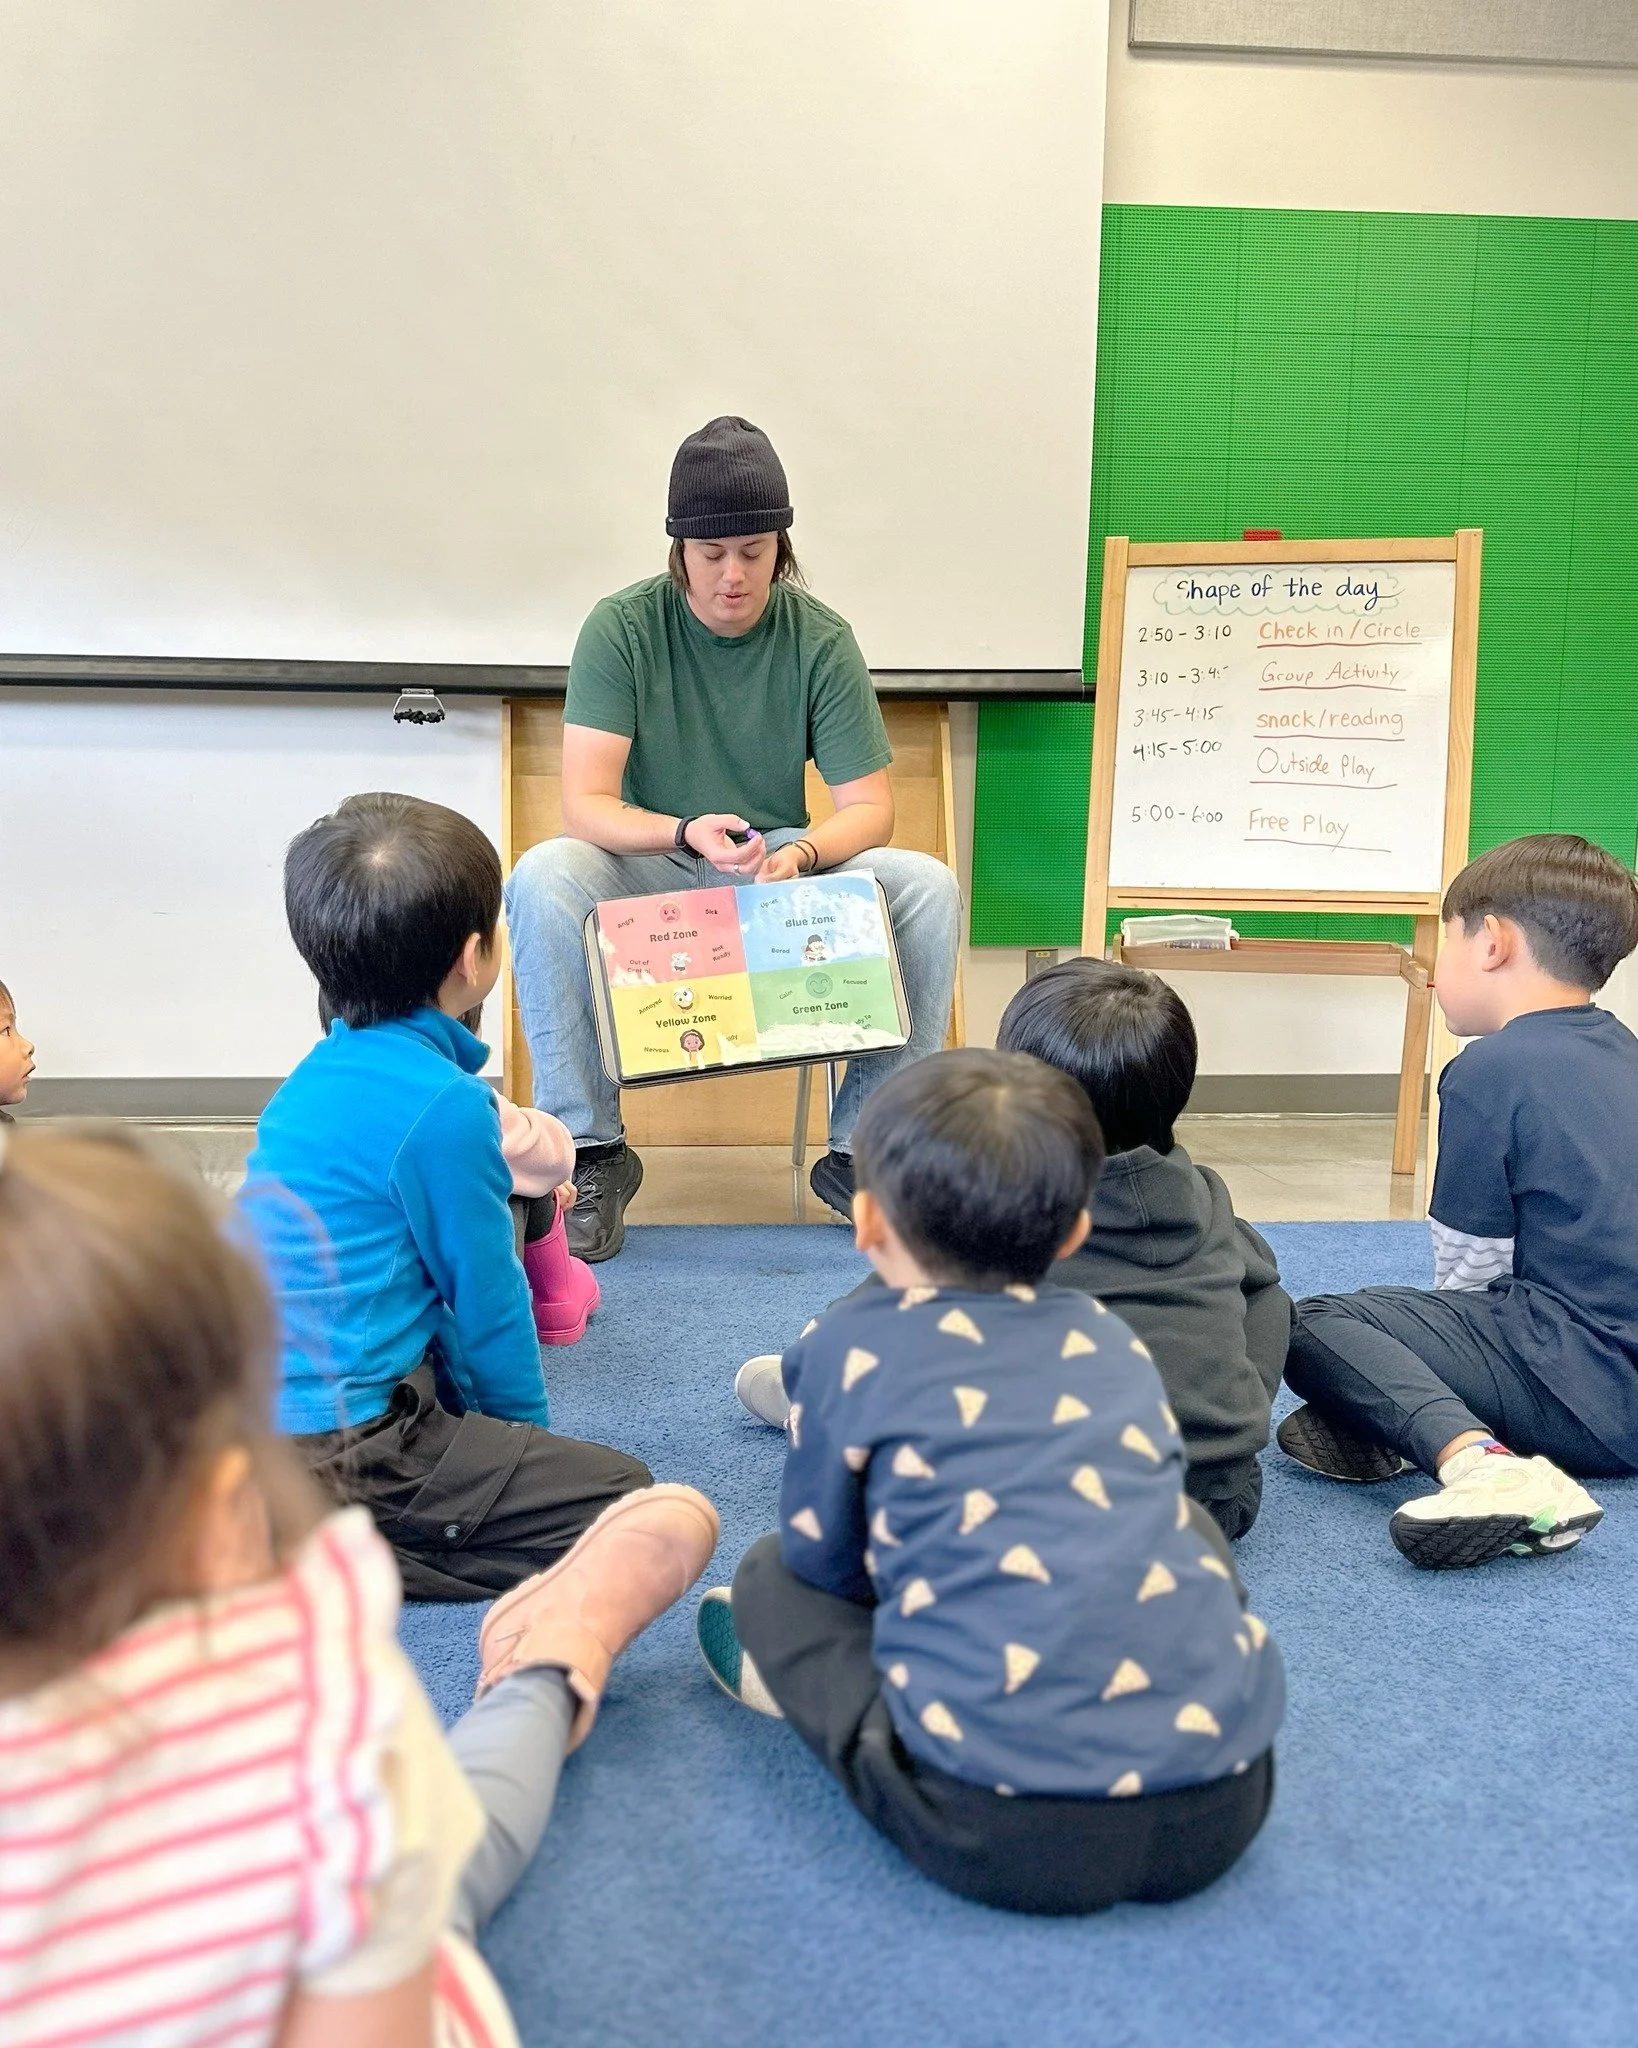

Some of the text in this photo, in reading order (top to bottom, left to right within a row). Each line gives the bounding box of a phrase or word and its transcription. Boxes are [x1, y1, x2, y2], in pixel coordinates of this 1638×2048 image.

[1251, 573, 1273, 597] of
[1283, 577, 1323, 597] the
[1336, 576, 1400, 611] day
[1259, 621, 1318, 640] Check
[1261, 661, 1400, 685] Group Activity
[1256, 747, 1330, 775] Outside
[1249, 808, 1349, 852] Free Play
[617, 917, 634, 929] Angry
[785, 915, 837, 928] Blue Zone
[649, 929, 698, 942] Red Zone
[712, 944, 724, 953] Not
[712, 951, 731, 962] Ready
[779, 989, 794, 1000] Calm
[638, 998, 663, 1015] Annoyed
[792, 1001, 849, 1015] Green Zone
[655, 1013, 717, 1028] Yellow Zone
